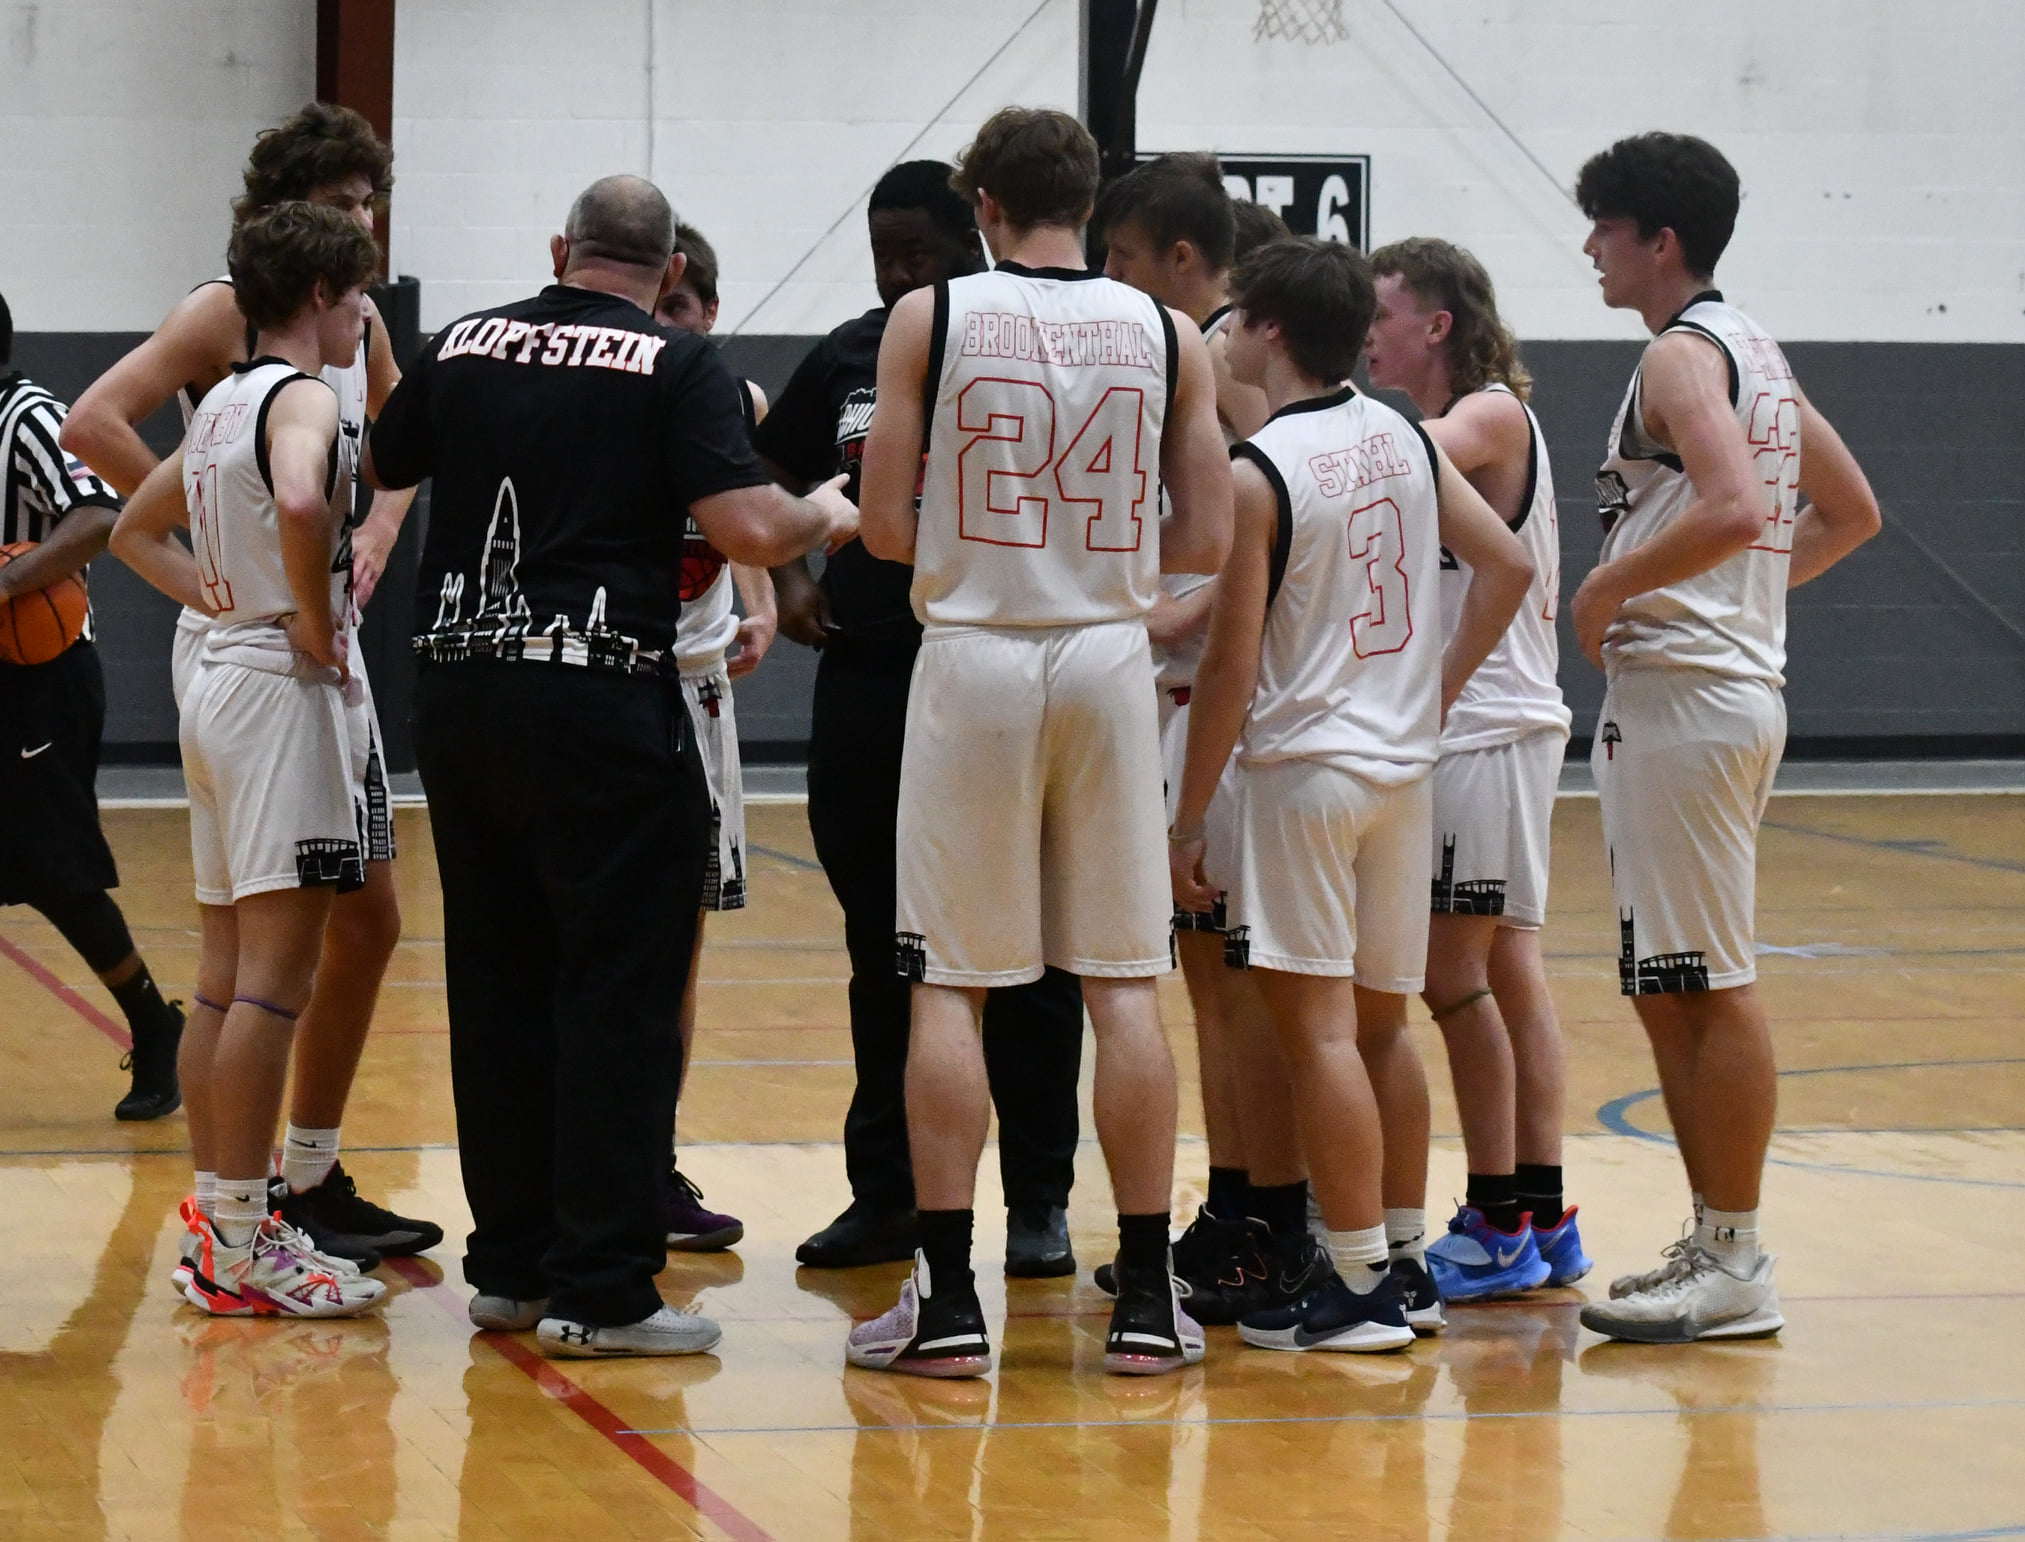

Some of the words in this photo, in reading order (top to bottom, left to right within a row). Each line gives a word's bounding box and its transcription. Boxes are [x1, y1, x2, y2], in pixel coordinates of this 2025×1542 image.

[1317, 174, 1350, 244] 6
[436, 316, 668, 376] KLOPFSTEIN
[957, 376, 1147, 553] 24
[1347, 496, 1414, 660] 3
